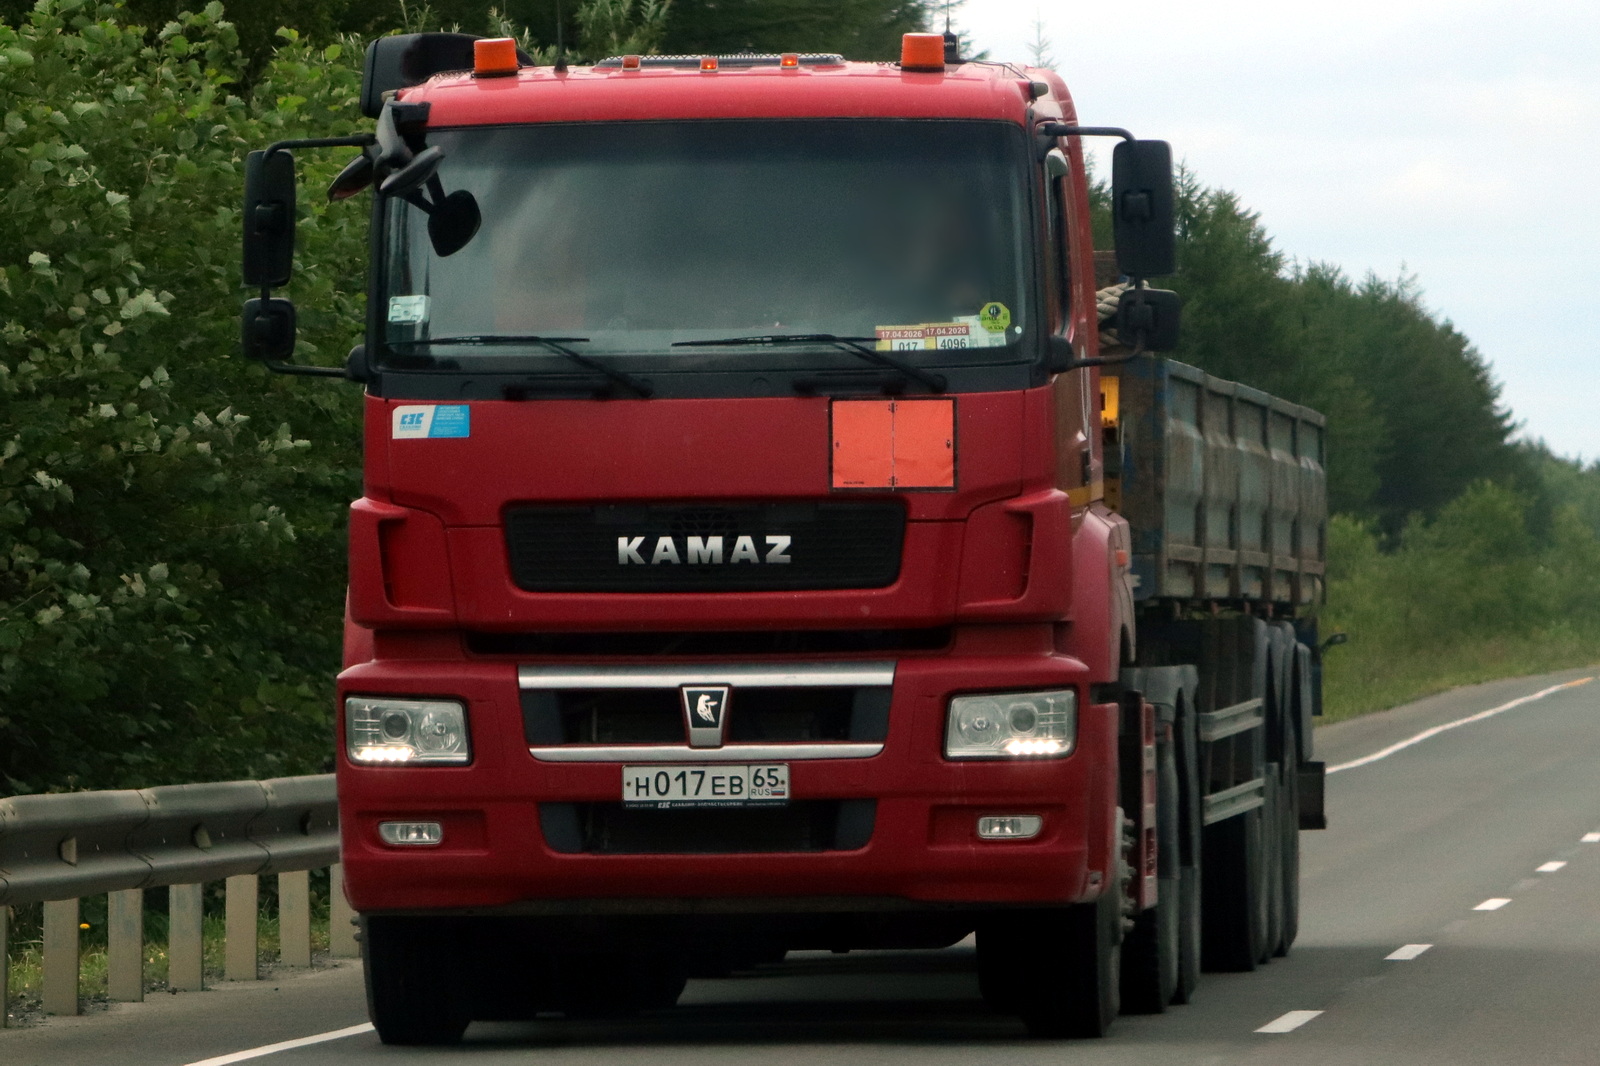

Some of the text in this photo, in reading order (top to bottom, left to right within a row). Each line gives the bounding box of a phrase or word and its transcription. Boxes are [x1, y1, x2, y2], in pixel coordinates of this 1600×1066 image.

[881, 330, 922, 339] 17.04.2026
[925, 326, 967, 336] 17.04.2026
[898, 341, 918, 351] 017
[940, 338, 967, 349] 4096
[617, 535, 792, 565] KAMAZ
[752, 767, 779, 788] 65
[751, 788, 771, 796] RUS
